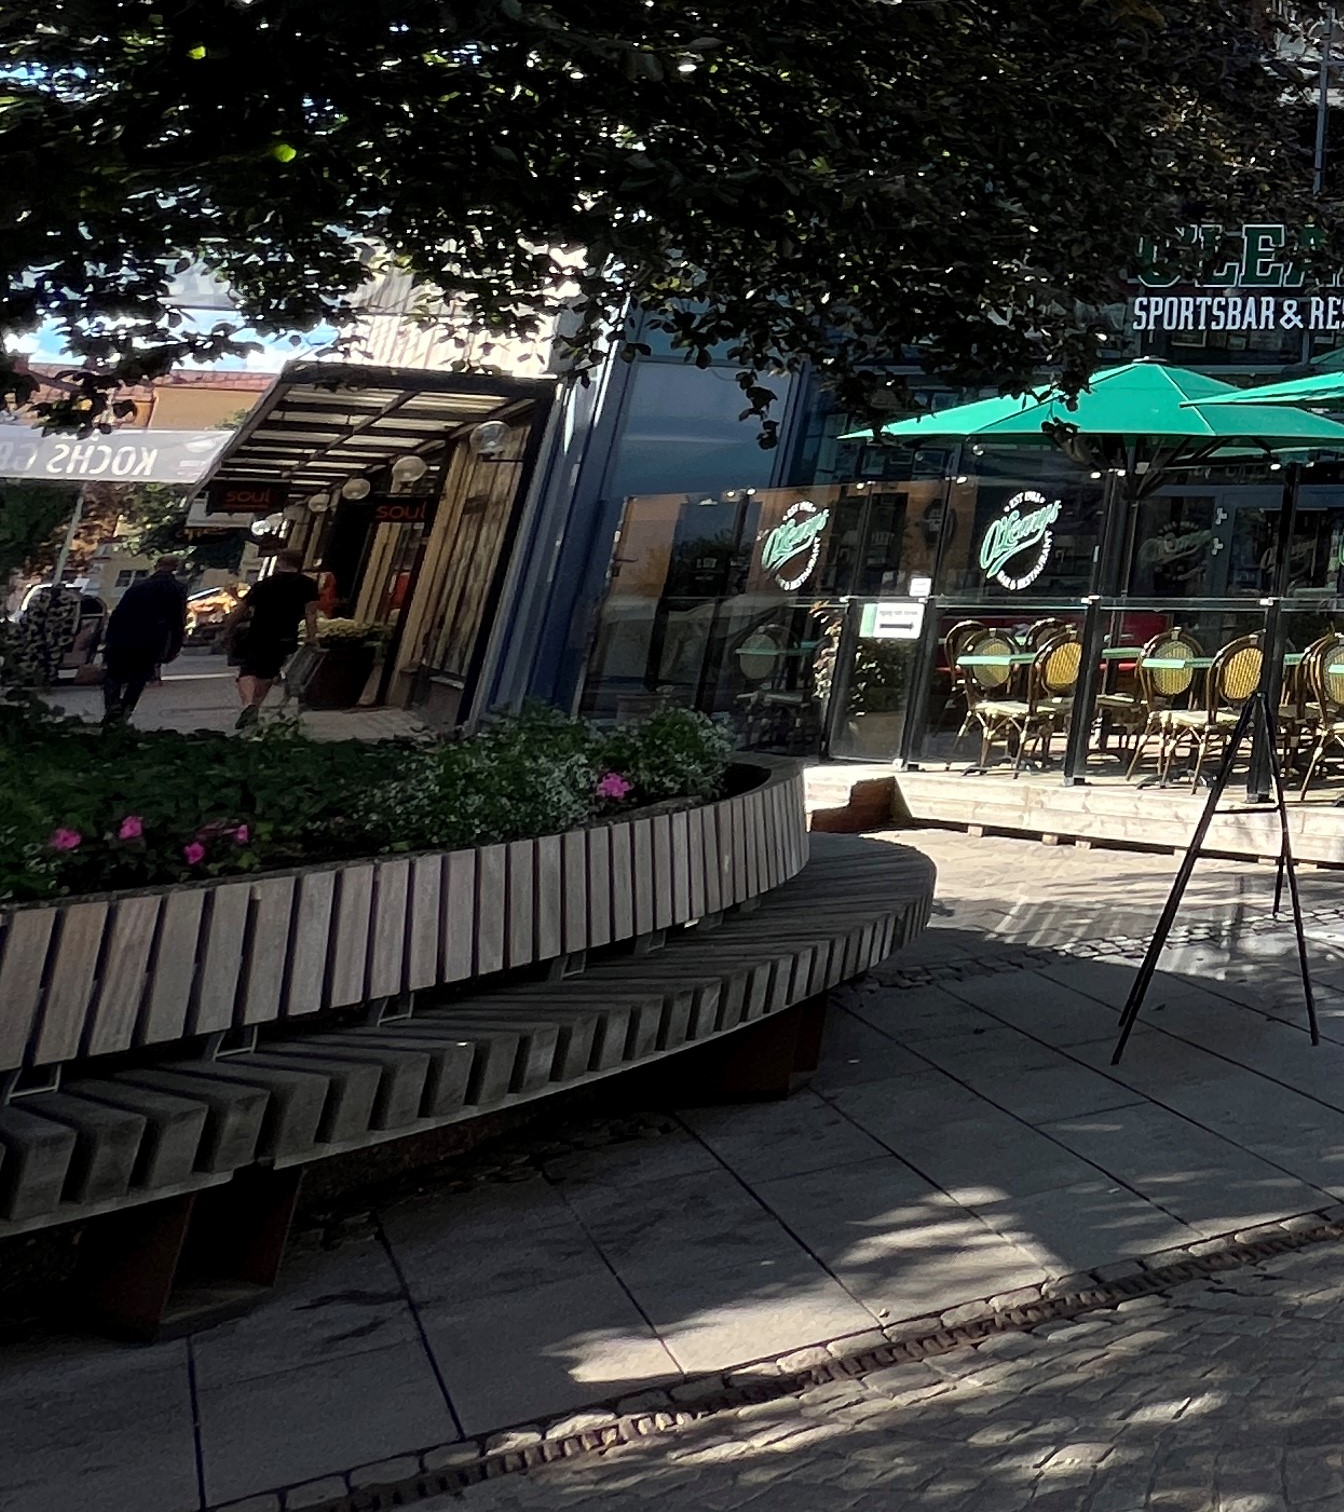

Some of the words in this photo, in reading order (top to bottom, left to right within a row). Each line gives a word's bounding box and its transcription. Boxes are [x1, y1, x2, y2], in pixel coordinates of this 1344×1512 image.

[1132, 296, 1275, 330] SPORTSBAR
[1279, 299, 1304, 330] &
[224, 489, 270, 505] soul
[375, 502, 427, 520] soul
